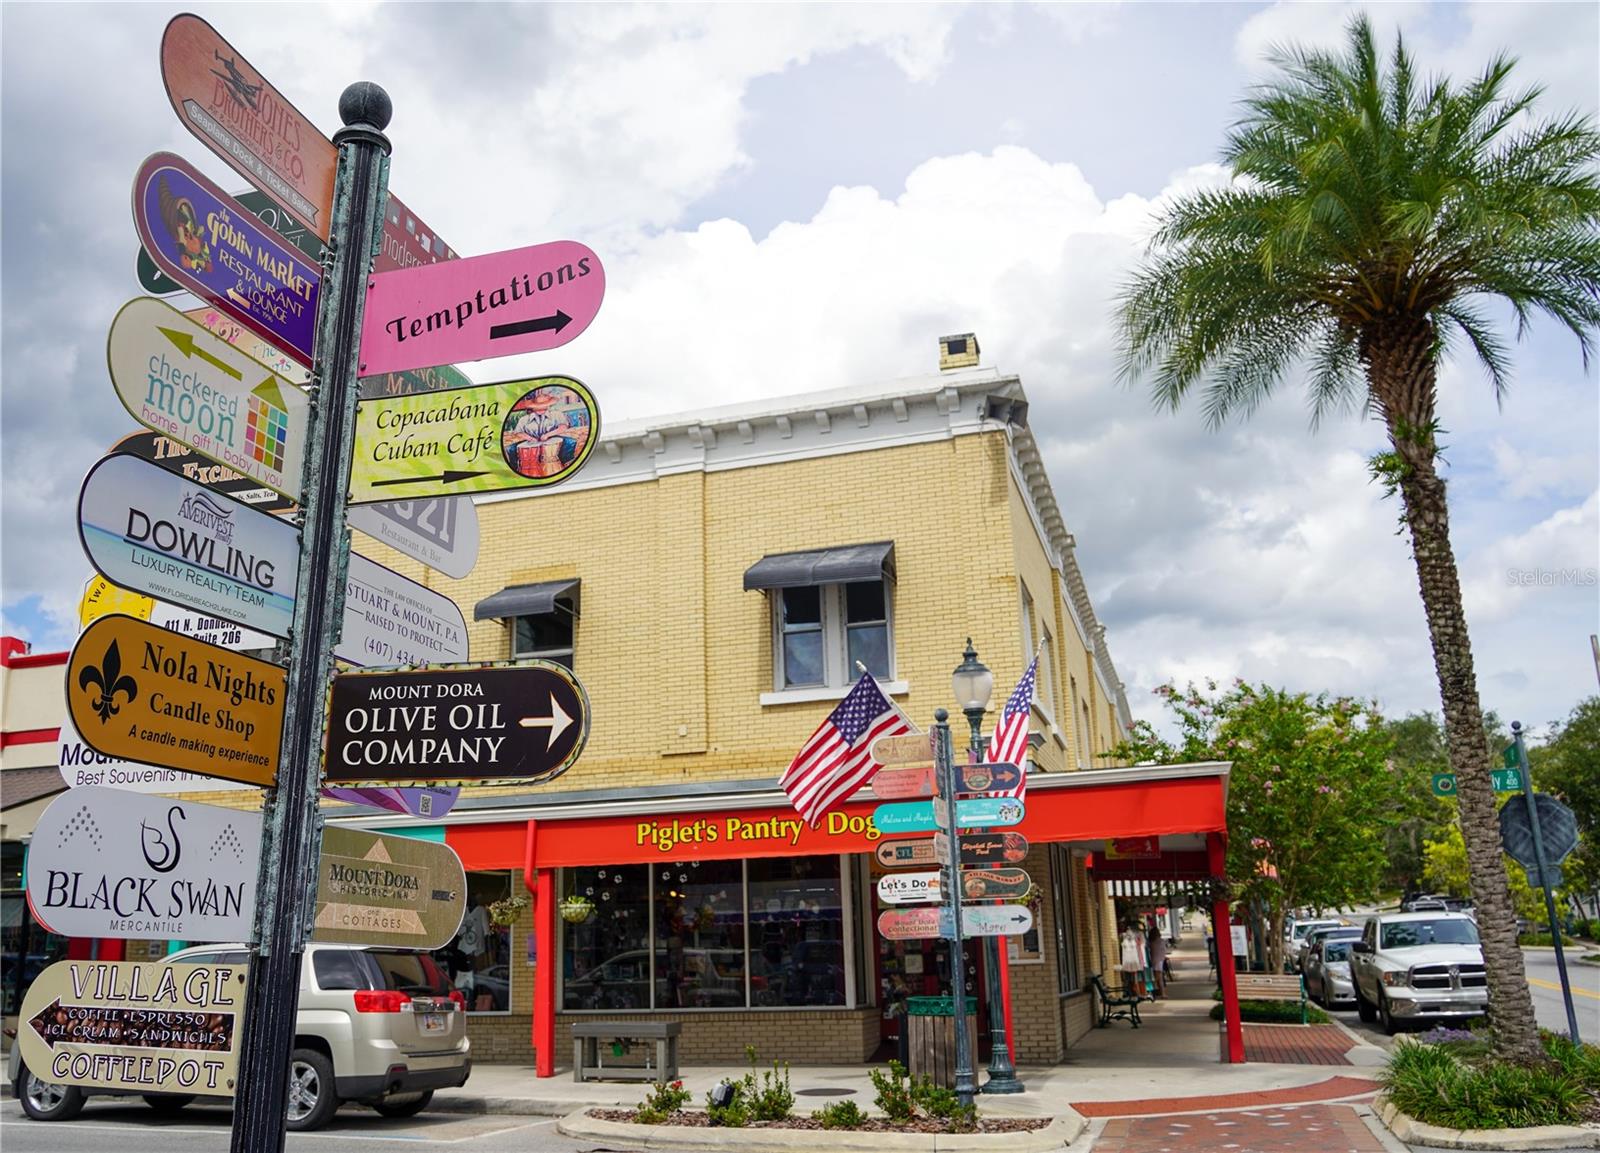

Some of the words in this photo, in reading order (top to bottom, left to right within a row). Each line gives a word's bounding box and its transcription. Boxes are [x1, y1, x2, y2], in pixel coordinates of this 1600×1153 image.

[213, 79, 274, 155] BROTHERS
[254, 80, 301, 152] JONES
[191, 104, 231, 146] Seaplane
[232, 143, 255, 170] Dock
[256, 166, 264, 177] &
[265, 172, 290, 201] Ticket
[291, 192, 314, 218] Sales
[219, 248, 305, 318] RESTAURANT
[235, 279, 244, 294] &
[248, 286, 289, 324] LOUNGE
[385, 256, 592, 343] Temptations
[149, 353, 239, 418] checkered
[144, 373, 235, 447] moon
[376, 397, 500, 439] Copacabana
[142, 404, 178, 435] home
[192, 433, 211, 451] gift
[223, 448, 253, 474] baby
[264, 470, 283, 488] you
[373, 433, 439, 462] Cuban
[447, 424, 496, 463] Café
[178, 503, 236, 538] AMERIVEST
[381, 522, 420, 553] Restaurant
[125, 506, 276, 589] DOWLING
[131, 549, 184, 578] LUXURY
[186, 568, 232, 596] REALTY
[234, 581, 265, 608] TEAM
[347, 582, 391, 612] STUART
[392, 603, 400, 617] &
[183, 619, 193, 632] N.
[221, 630, 242, 645] 206
[365, 610, 395, 632] RAISED
[397, 623, 408, 637] TO
[409, 629, 444, 653] PROTECT
[364, 636, 394, 662] (407)
[141, 639, 198, 684] Nola
[204, 660, 276, 707] Nights
[369, 685, 432, 700] MOUNT
[436, 683, 485, 698] DORA
[149, 692, 211, 725] Candle
[215, 709, 255, 742] Shop
[344, 705, 437, 734] OLIVE
[449, 703, 506, 731] OIL
[128, 724, 137, 738] A
[140, 727, 177, 747] candle
[179, 738, 217, 758] making
[218, 746, 271, 767] experience
[342, 736, 506, 765] COMPANY
[76, 769, 106, 786] Best
[108, 767, 177, 785] Souvenirs
[636, 818, 718, 852] Piglet's
[726, 816, 804, 846] Pantry
[42, 869, 162, 918] BLACK
[168, 877, 245, 920] SWAN
[329, 863, 382, 886] MOUNT
[384, 870, 420, 890] DORA
[340, 884, 388, 898] HISTORIC
[880, 878, 908, 890] Let's
[912, 879, 927, 888] Do
[109, 919, 184, 933] MERCANTILE
[342, 914, 402, 929] COTTAGES
[70, 964, 234, 1007] VILLAGE
[46, 1022, 68, 1036] ICE
[72, 1024, 118, 1041] CREAM
[131, 1028, 227, 1044] SANDWICHES
[68, 1007, 119, 1020] COFFEE
[130, 1011, 206, 1027] ESPRESSO
[52, 1051, 225, 1089] COFFEEPOT
